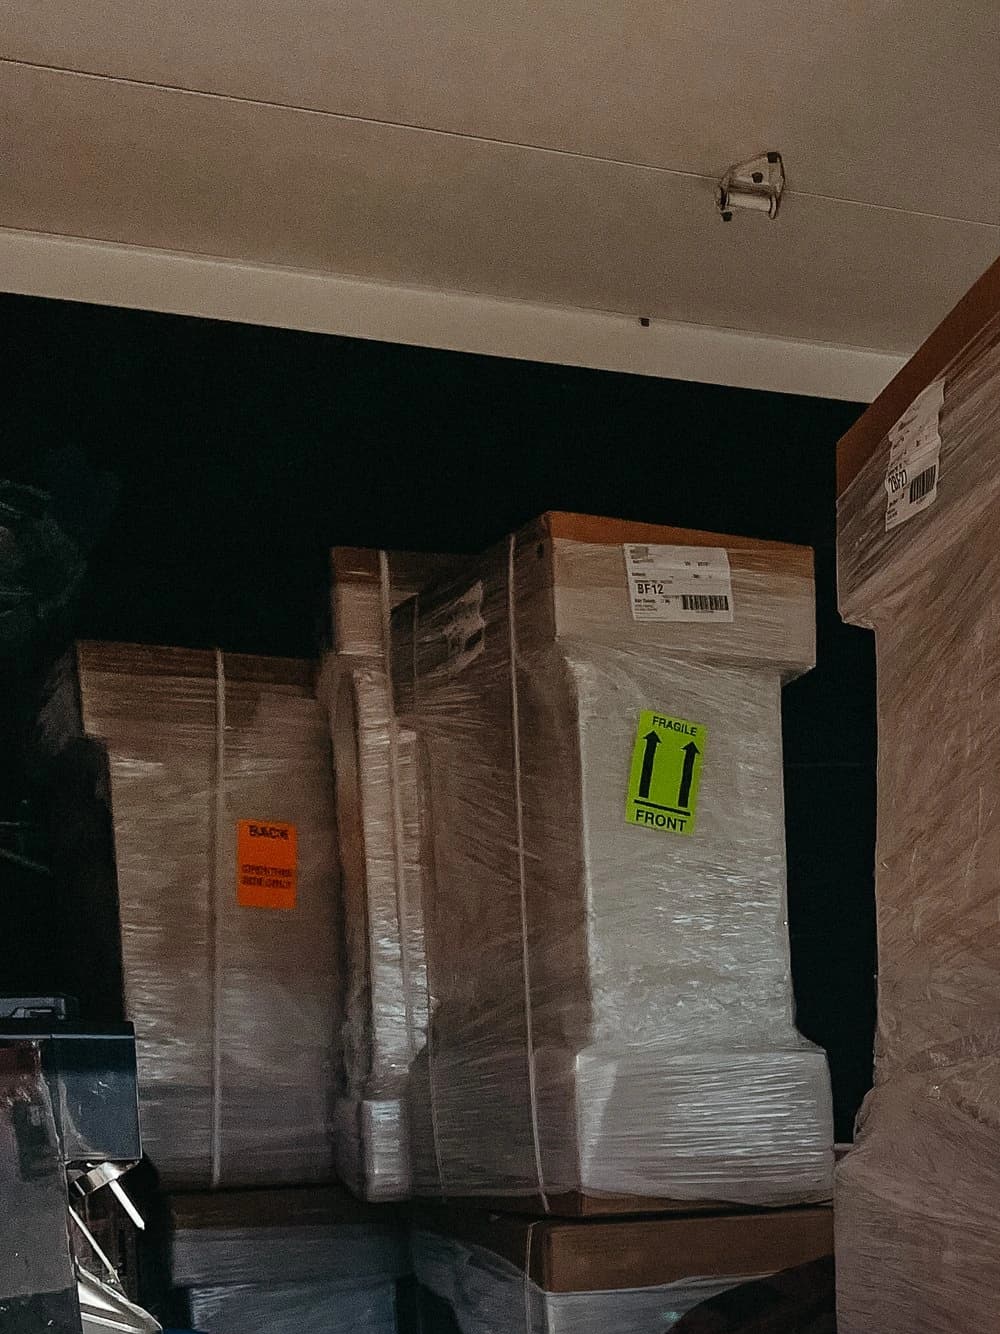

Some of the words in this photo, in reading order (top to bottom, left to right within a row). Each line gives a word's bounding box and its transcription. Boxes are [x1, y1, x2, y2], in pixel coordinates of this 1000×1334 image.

[637, 583, 664, 595] BF12
[652, 715, 698, 737] FRAGILE
[635, 809, 687, 832] FRONT
[248, 824, 290, 840] BACK
